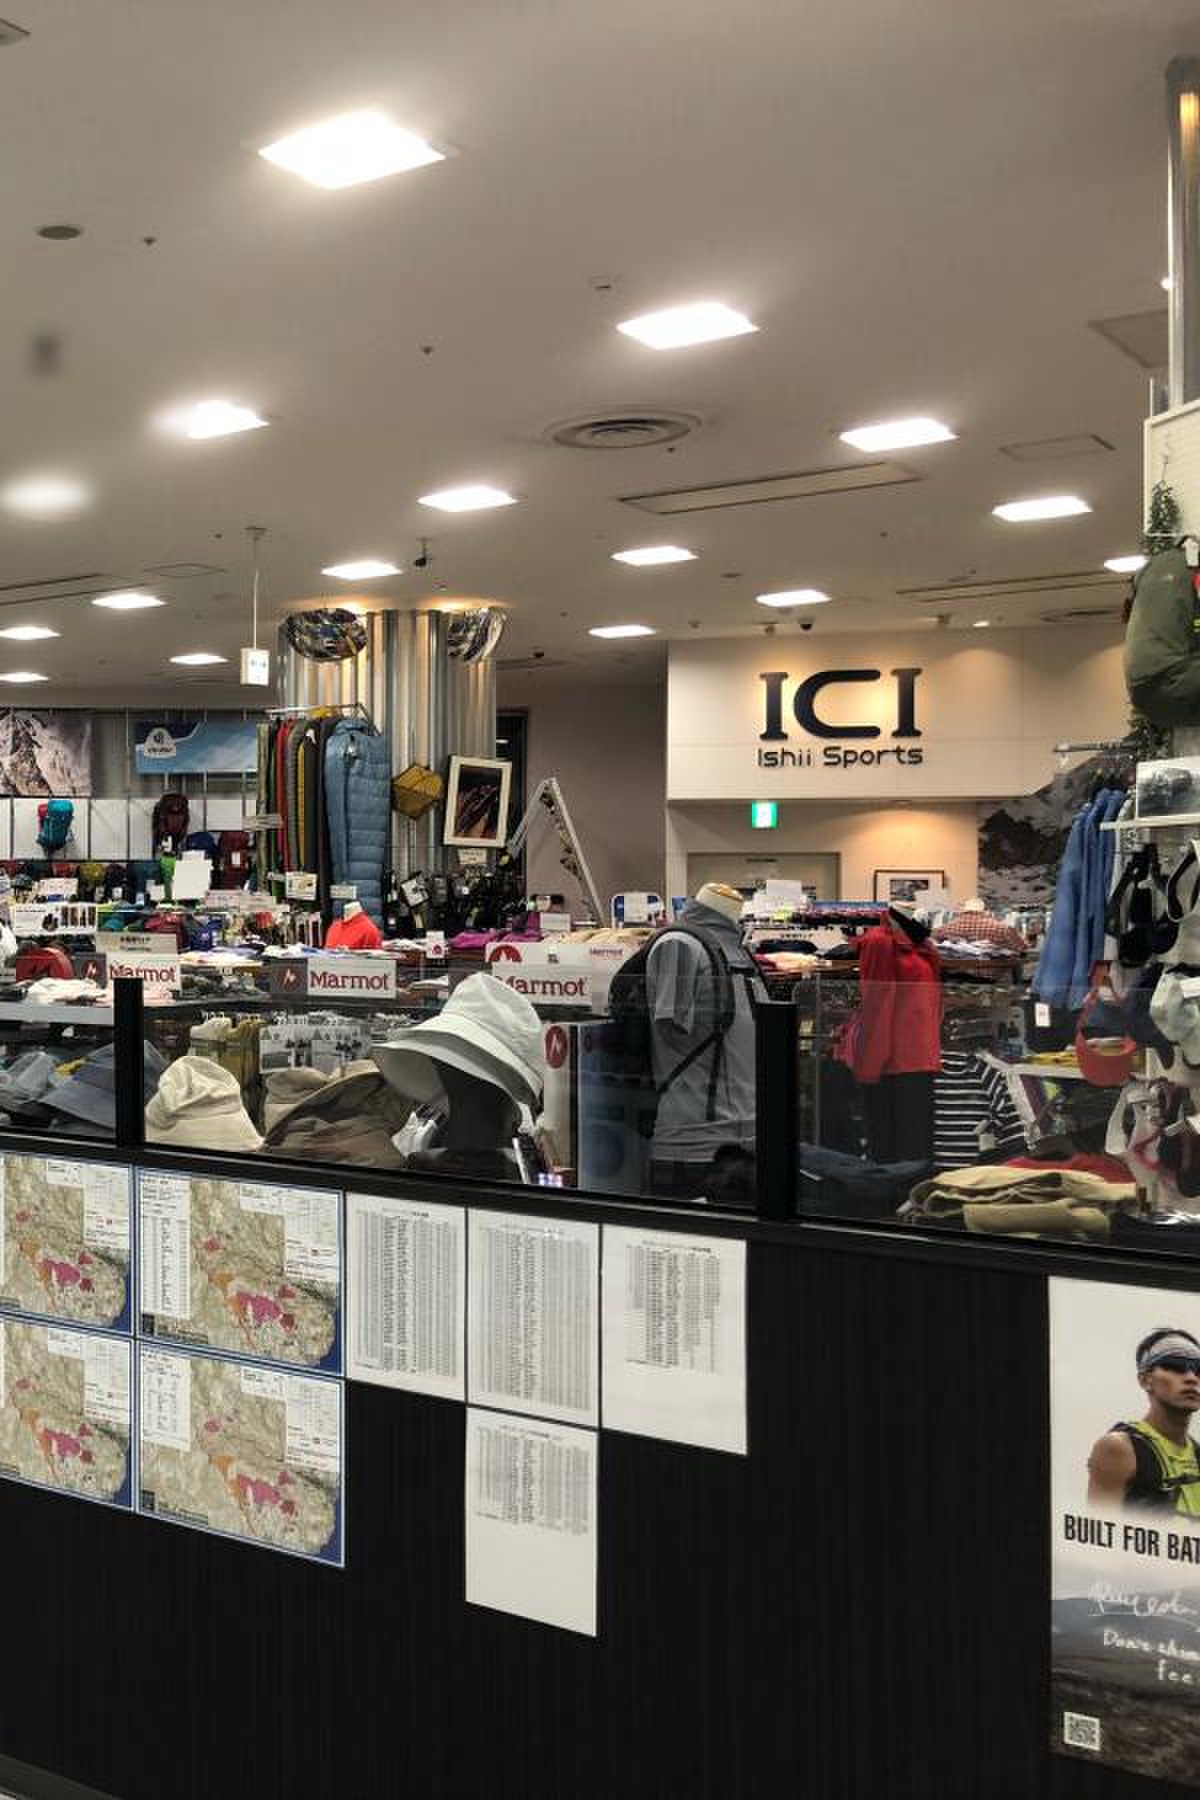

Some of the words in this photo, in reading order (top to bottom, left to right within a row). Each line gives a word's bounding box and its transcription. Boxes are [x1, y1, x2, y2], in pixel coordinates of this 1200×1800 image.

[759, 668, 923, 740] ICI
[757, 747, 812, 768] Ishii
[823, 745, 923, 768] Sports
[309, 969, 390, 991] Marmot
[1063, 1514, 1117, 1549] BUILT
[1123, 1525, 1160, 1557] FOR
